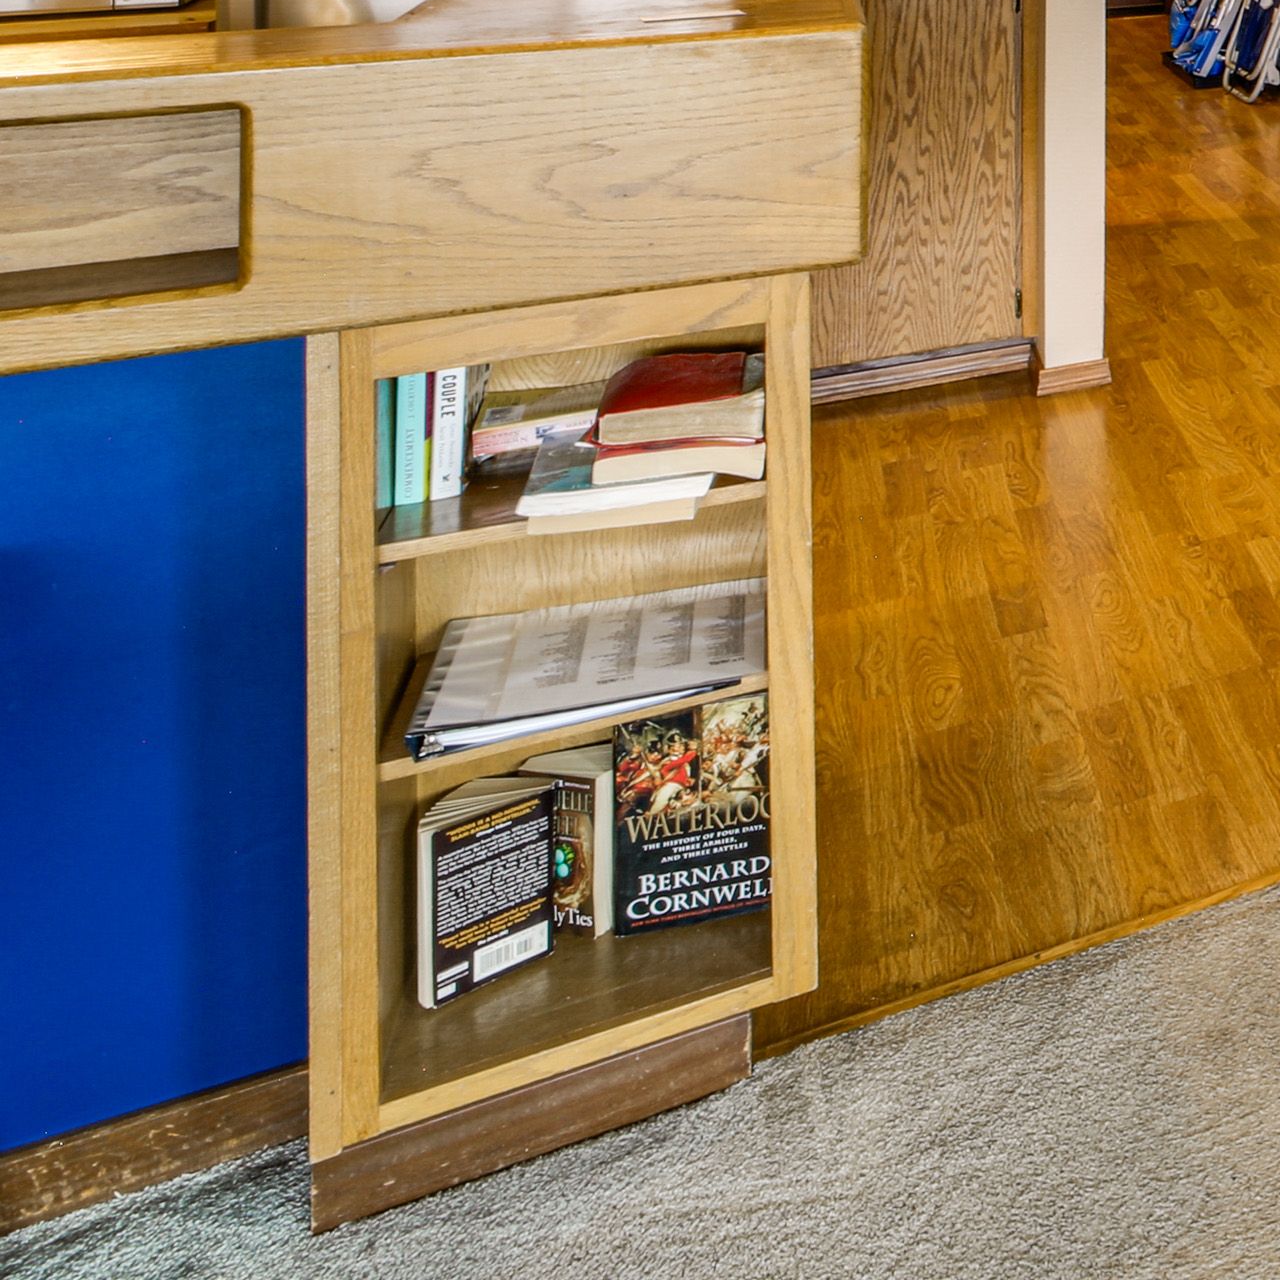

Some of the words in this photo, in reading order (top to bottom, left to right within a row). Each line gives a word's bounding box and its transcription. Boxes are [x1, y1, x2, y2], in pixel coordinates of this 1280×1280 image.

[440, 374, 458, 419] COUPLE
[642, 841, 661, 852] THE
[662, 834, 702, 848] HISTORY
[702, 830, 715, 841] OF
[716, 827, 741, 838] FOUR
[672, 844, 701, 854] THREE
[660, 852, 682, 864] AND
[682, 849, 711, 858] THREE
[712, 842, 749, 854] BATTLES
[637, 855, 771, 896] BERNARD
[566, 907, 593, 927] Ties
